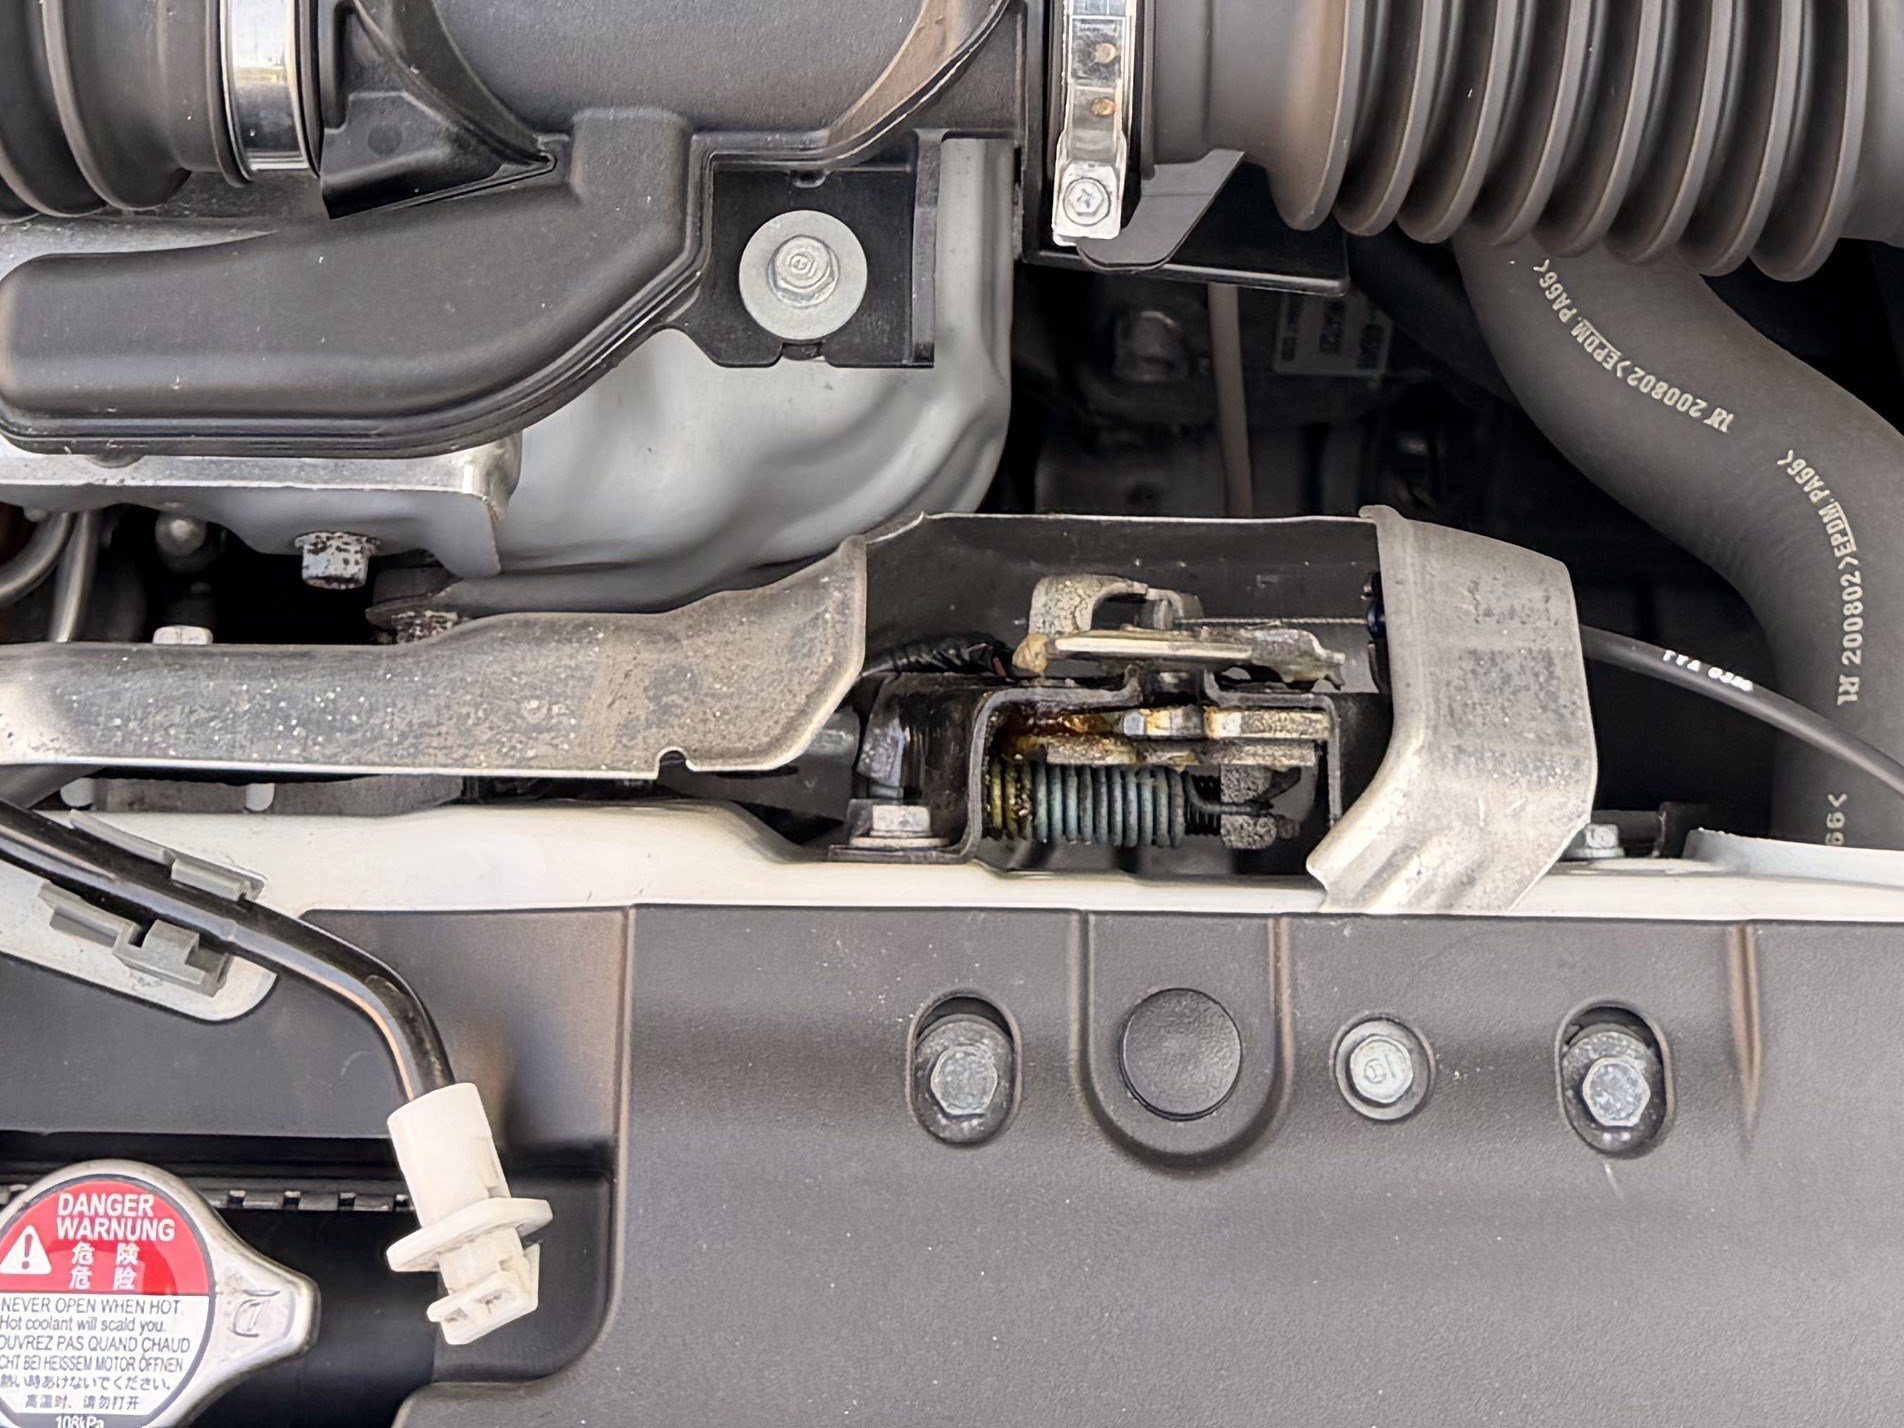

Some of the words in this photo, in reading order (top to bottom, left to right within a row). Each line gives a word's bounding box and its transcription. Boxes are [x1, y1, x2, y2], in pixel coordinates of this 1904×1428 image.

[57, 1193, 155, 1217] DANGER
[55, 1217, 177, 1242] WARNUNG
[1, 1297, 51, 1313] NEVER
[55, 1298, 97, 1314] OPEN
[100, 1298, 146, 1315] WHEN
[25, 1315, 73, 1331] coolant
[77, 1316, 98, 1332] will
[101, 1317, 136, 1333] scald
[139, 1320, 167, 1337] you.
[57, 1335, 85, 1352] PAS
[88, 1336, 139, 1353] QUAND
[142, 1337, 191, 1354] CHAUD
[23, 1355, 42, 1371] BEI
[44, 1355, 93, 1372] HEISSEM
[95, 1355, 136, 1372] MOTOR
